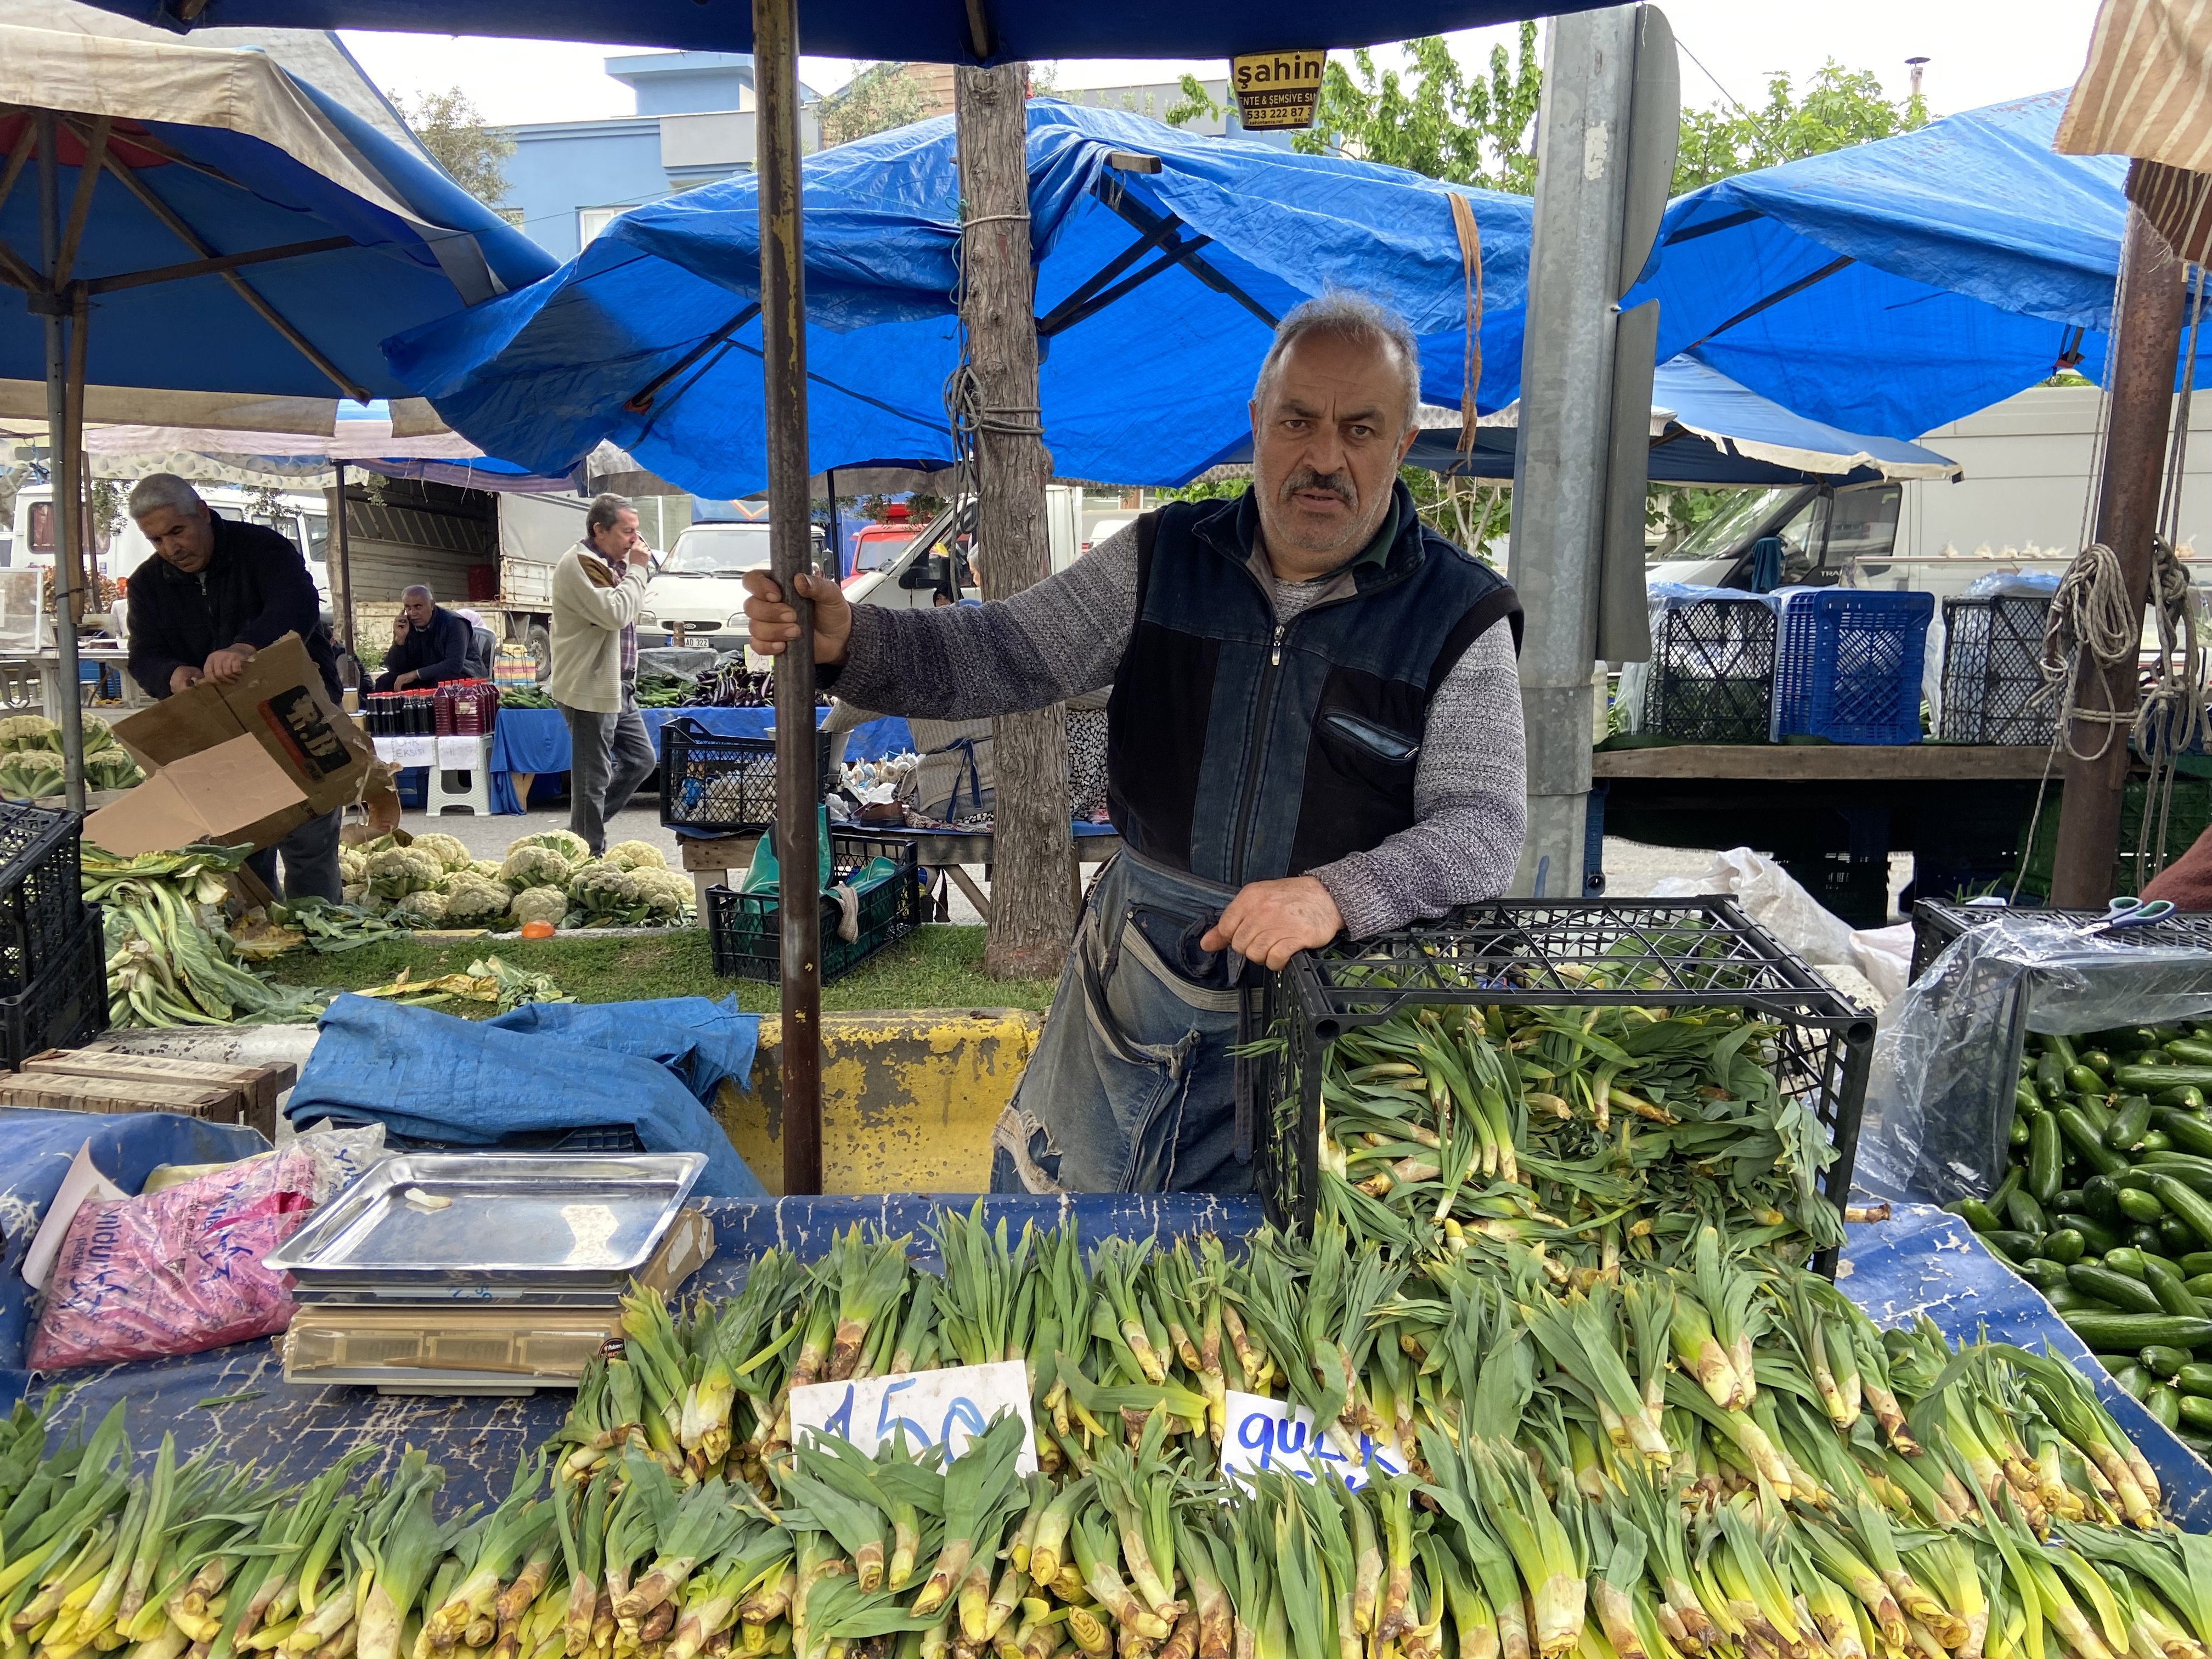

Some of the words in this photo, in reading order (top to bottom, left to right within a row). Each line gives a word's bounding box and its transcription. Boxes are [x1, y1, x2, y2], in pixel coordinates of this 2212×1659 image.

[1237, 54, 1320, 89] şahin
[1261, 95, 1267, 105] &
[1269, 92, 1302, 107] ŞEMSİYE
[1270, 108, 1288, 119] 222
[1290, 107, 1304, 117] 87
[696, 639, 708, 647] 322
[825, 1378, 986, 1466] 150
